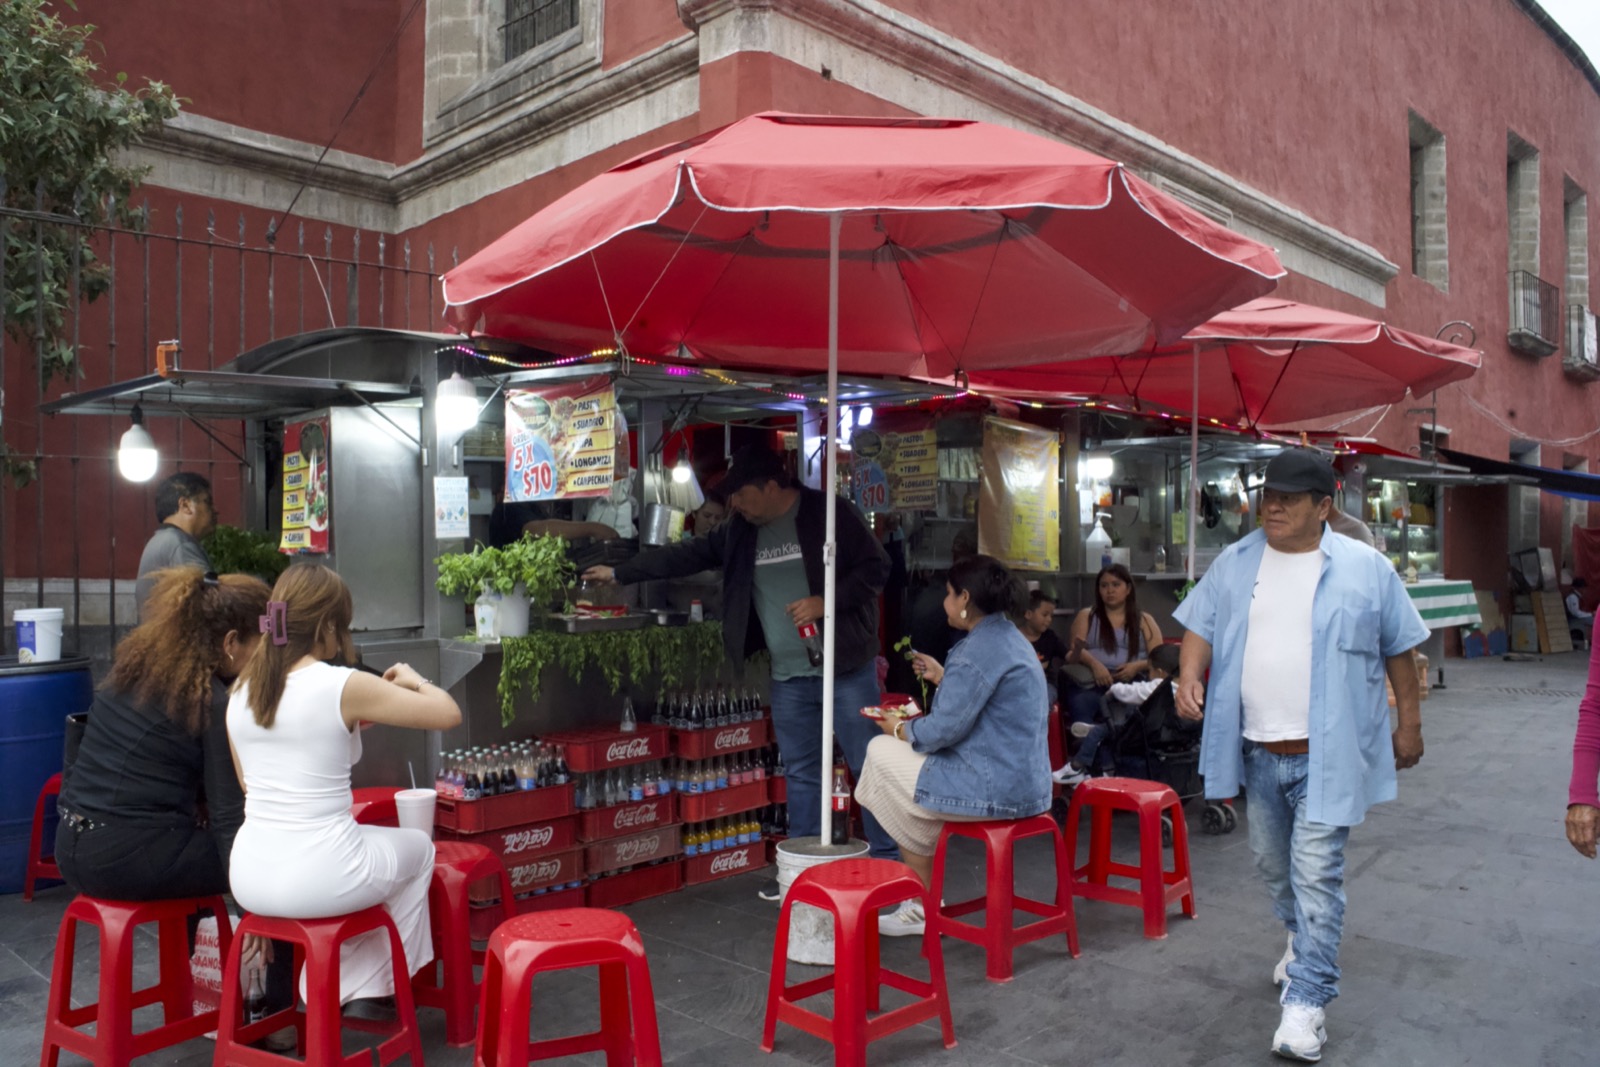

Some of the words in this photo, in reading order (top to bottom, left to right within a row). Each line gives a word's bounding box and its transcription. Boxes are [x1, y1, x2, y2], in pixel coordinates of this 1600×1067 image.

[514, 448, 523, 470] 5
[524, 462, 552, 496] $70
[862, 482, 885, 508] $70
[756, 547, 781, 560] alvin
[606, 737, 649, 762] Coca-Cola
